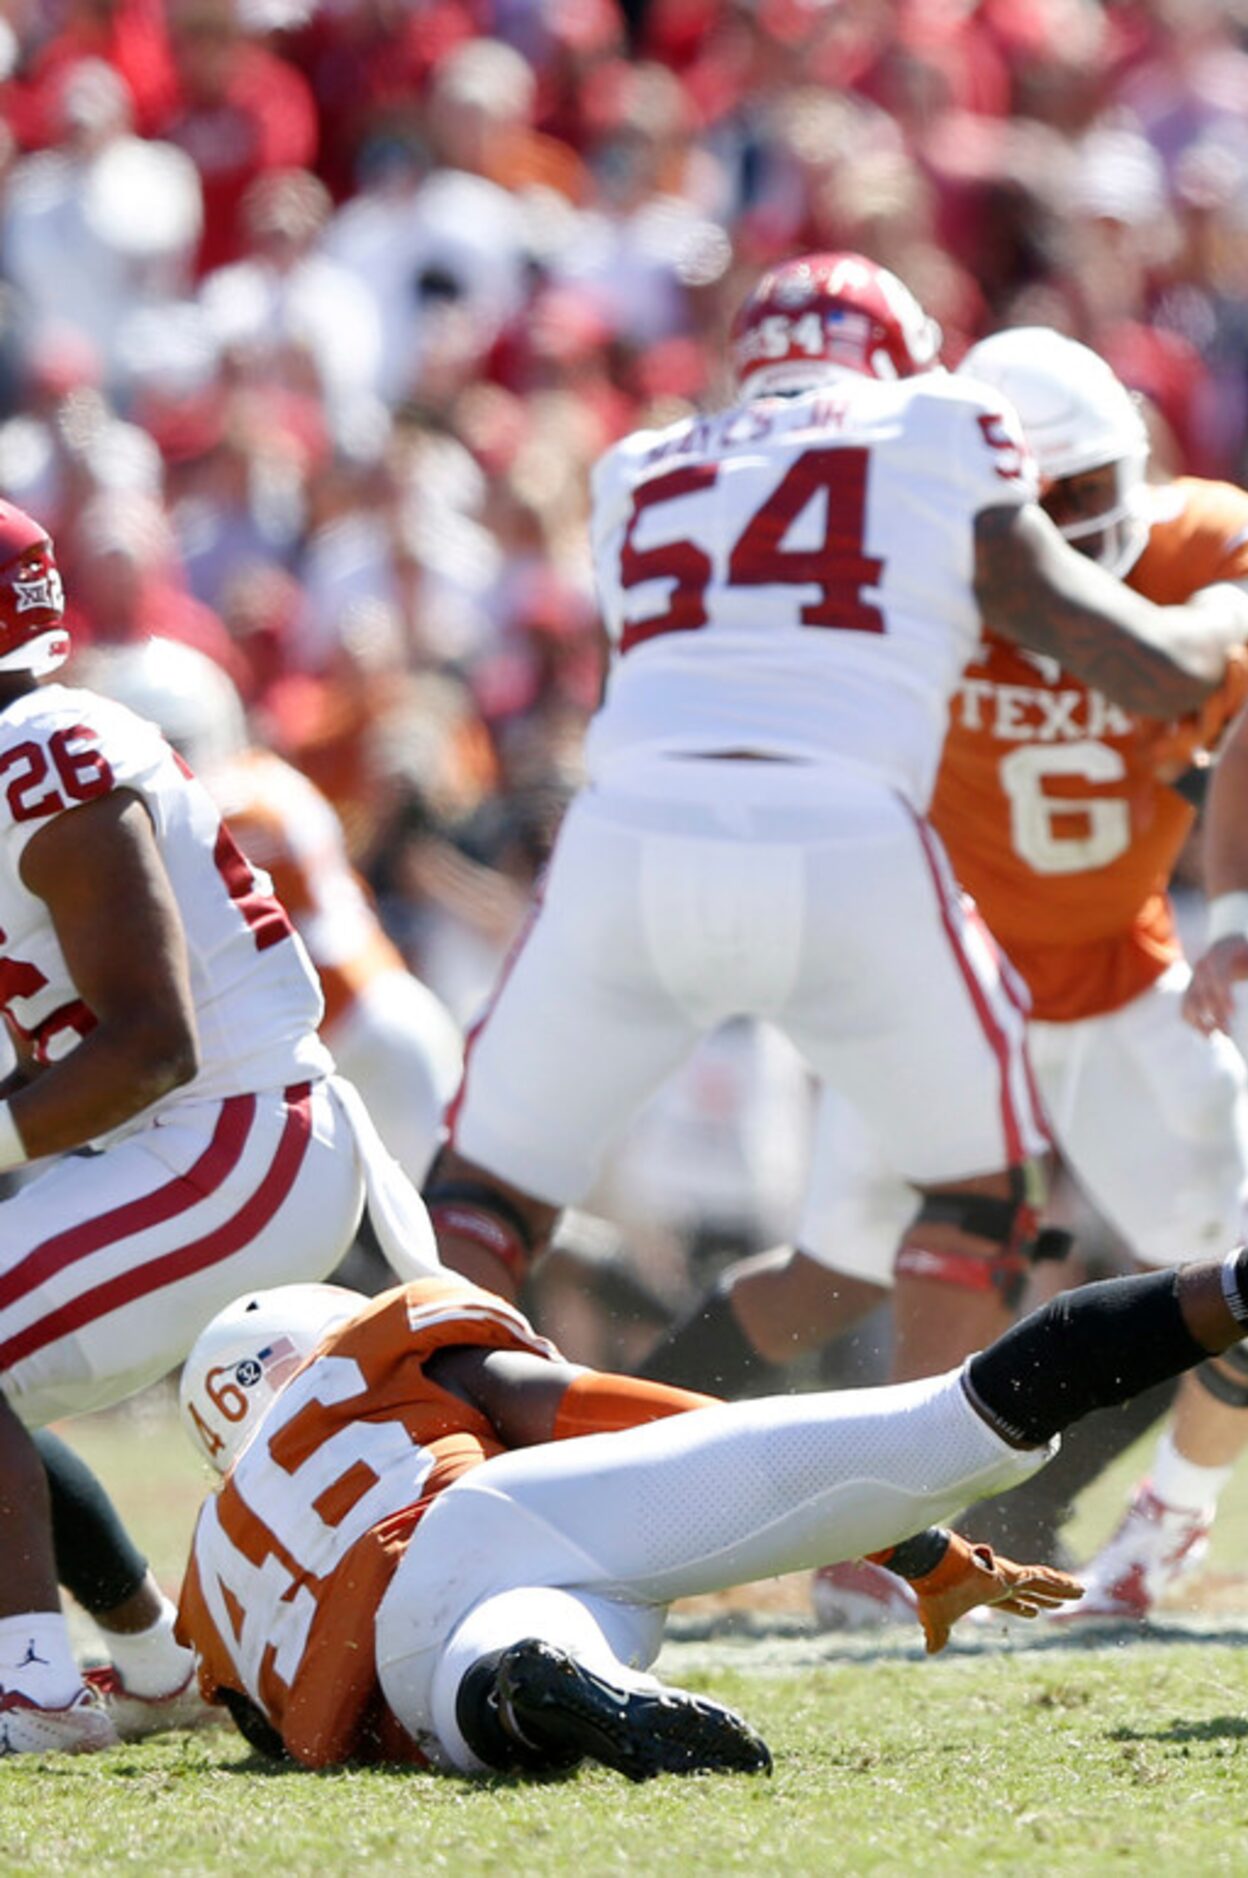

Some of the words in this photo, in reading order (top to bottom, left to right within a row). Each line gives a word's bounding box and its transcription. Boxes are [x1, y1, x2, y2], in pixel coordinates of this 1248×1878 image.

[760, 313, 823, 358] 54
[619, 446, 886, 655] 54
[0, 725, 117, 823] 26
[1000, 738, 1132, 876] 6
[188, 1366, 249, 1457] 46
[194, 1355, 436, 1712] 46
